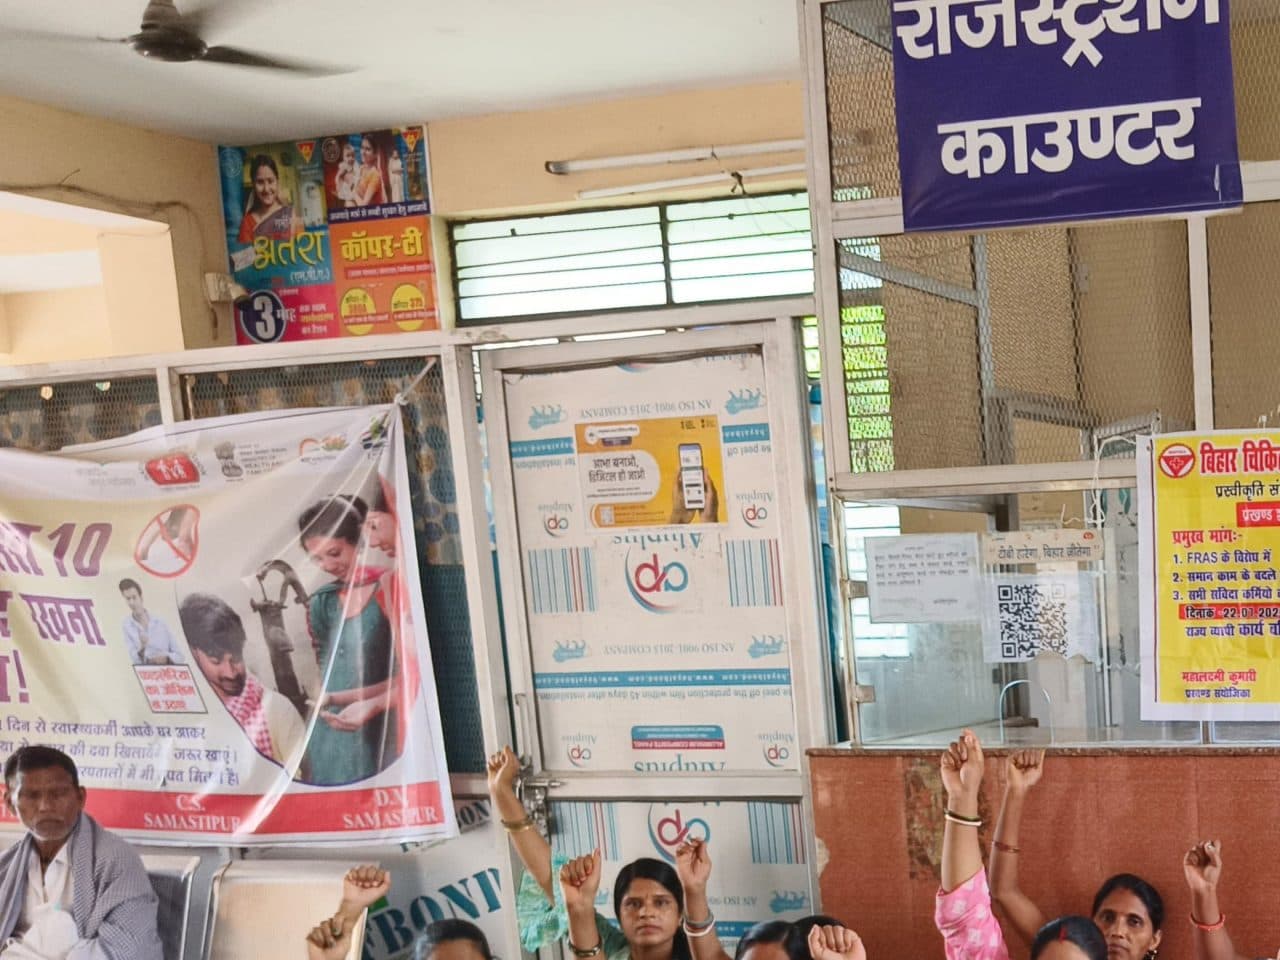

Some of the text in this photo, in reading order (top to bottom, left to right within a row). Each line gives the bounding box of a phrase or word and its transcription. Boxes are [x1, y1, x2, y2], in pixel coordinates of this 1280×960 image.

[937, 98, 1202, 179] काउण्टर
[254, 295, 276, 340] 3
[1201, 441, 1237, 474] बिहार
[1215, 480, 1265, 501] प्रस्वीकृति
[1172, 530, 1203, 548] प्रमुख
[48, 523, 112, 577] 10
[1187, 552, 1218, 563] FRAS
[1221, 549, 1230, 562] के
[1263, 549, 1272, 562] में
[1187, 571, 1213, 581] समान
[1217, 571, 1237, 581] काम
[1241, 568, 1250, 580] के
[1188, 586, 1206, 600] सभी
[19, 593, 106, 646] रखना
[1238, 619, 1264, 636] कार्य
[1228, 669, 1256, 685] कुमारी
[143, 812, 242, 833] SAMASTIPUR
